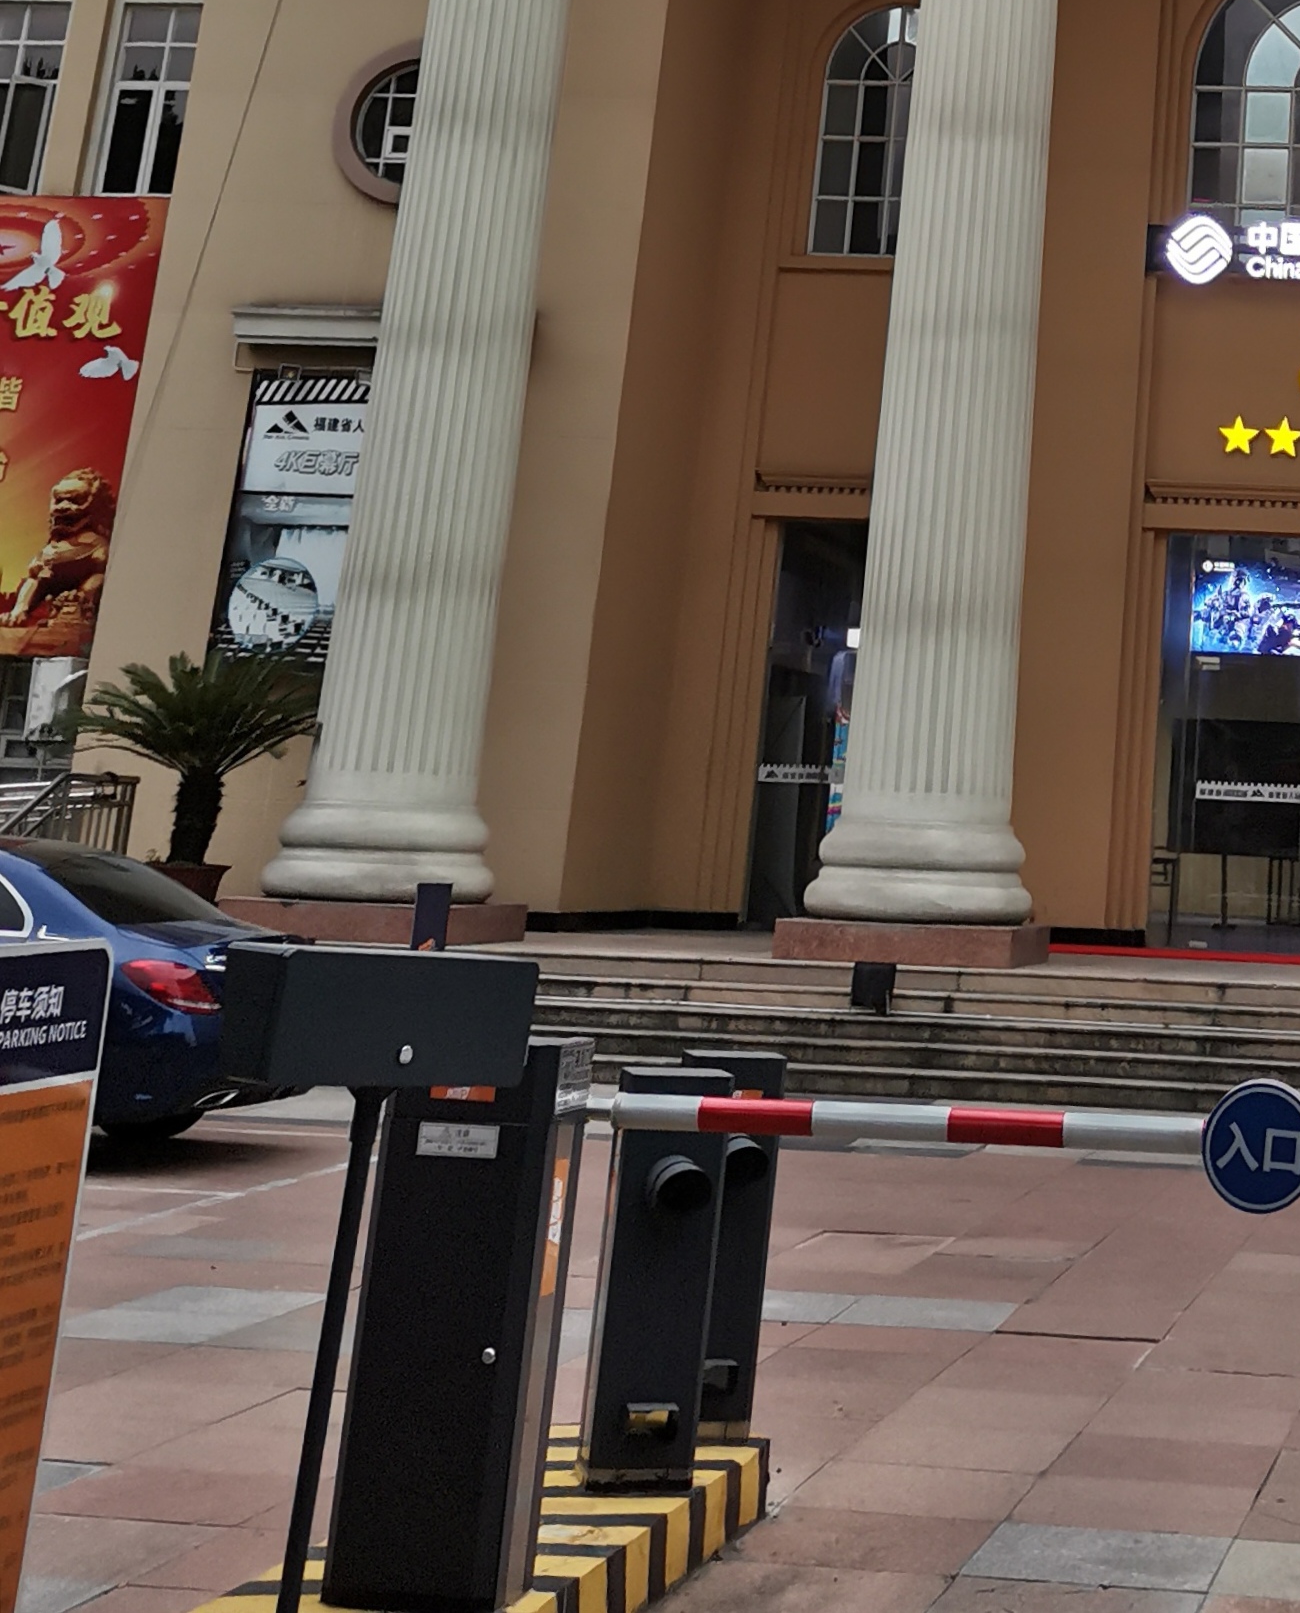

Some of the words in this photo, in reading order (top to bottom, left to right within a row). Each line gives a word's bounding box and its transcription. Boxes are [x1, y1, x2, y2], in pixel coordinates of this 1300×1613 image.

[0, 286, 122, 338] 值观
[0, 985, 64, 1024] 停车须知
[0, 1025, 48, 1049] PARKING
[48, 1020, 88, 1043] NOTICE
